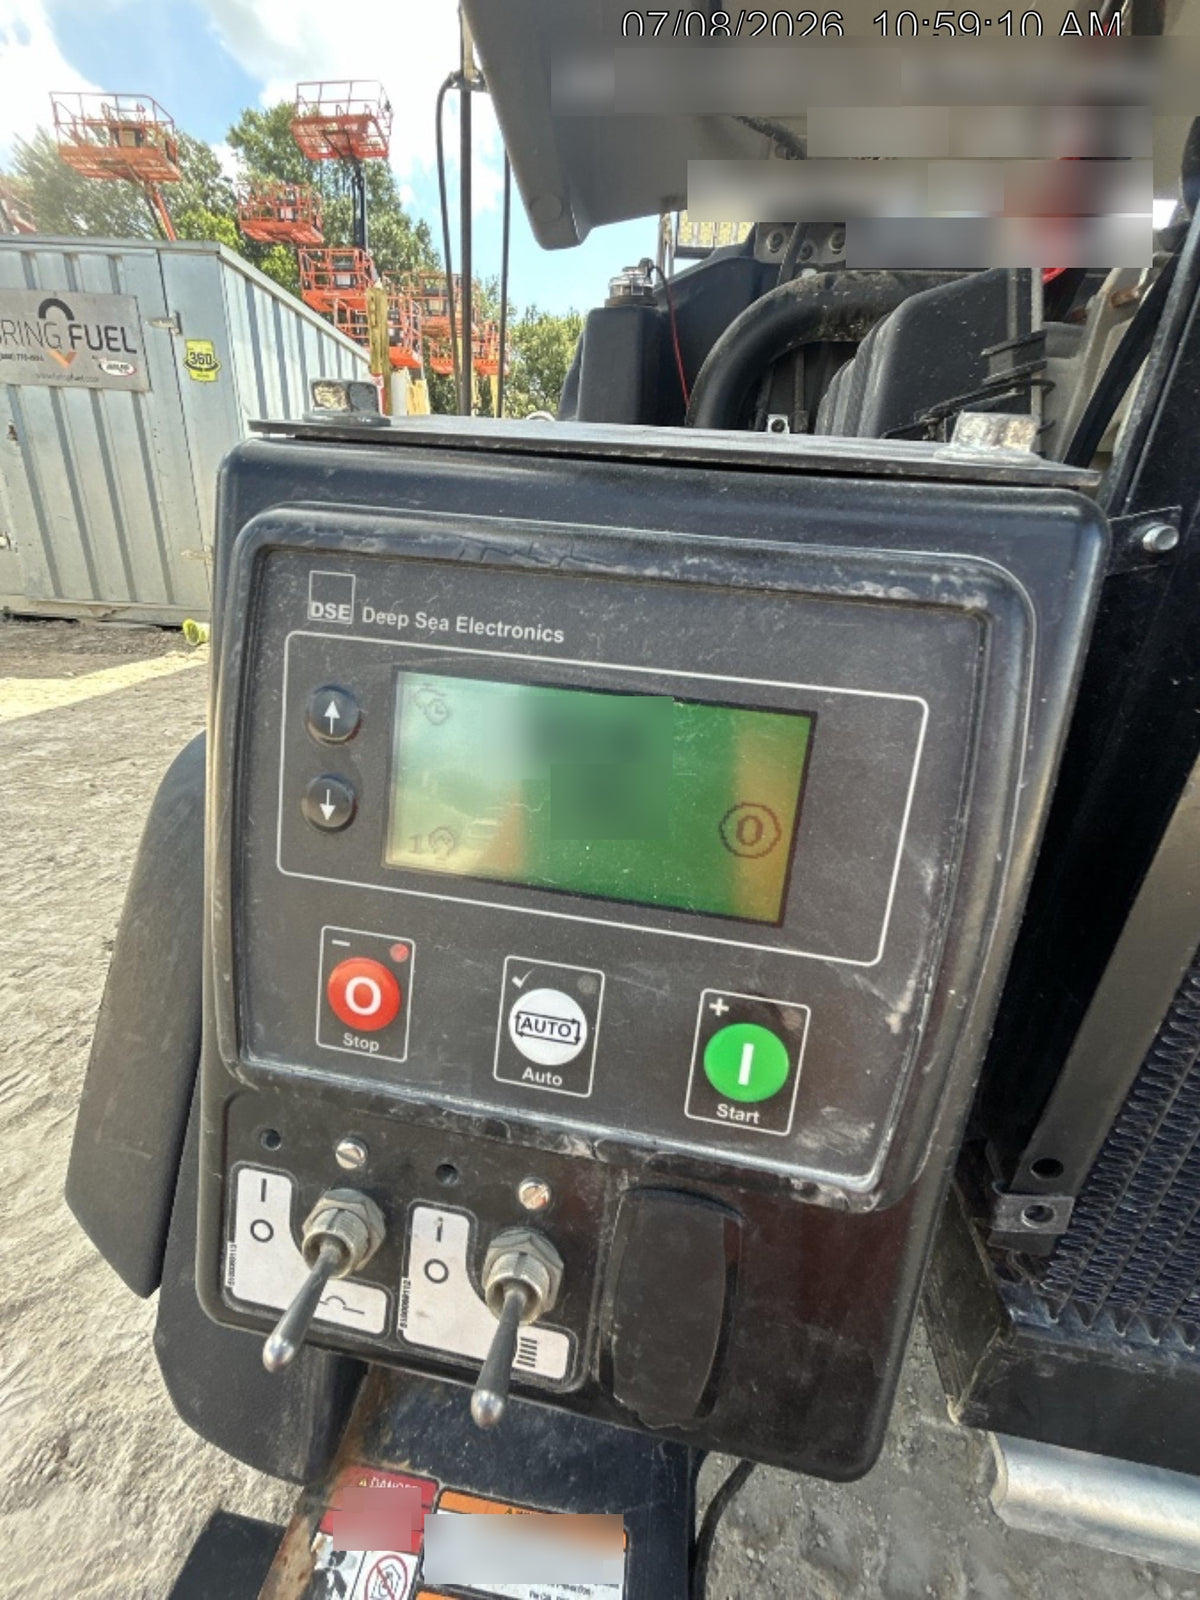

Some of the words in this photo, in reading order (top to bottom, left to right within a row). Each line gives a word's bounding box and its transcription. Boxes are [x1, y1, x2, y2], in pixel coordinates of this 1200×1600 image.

[68, 323, 138, 354] FUEL
[189, 351, 213, 366] 360
[310, 601, 351, 621] DSE
[362, 606, 410, 630] Deep
[414, 612, 450, 632] Sea
[455, 616, 566, 644] Electronics
[519, 1015, 574, 1040] AUTO
[342, 1032, 380, 1054] Stop
[521, 1065, 564, 1088] Auto
[715, 1103, 761, 1126] Start
